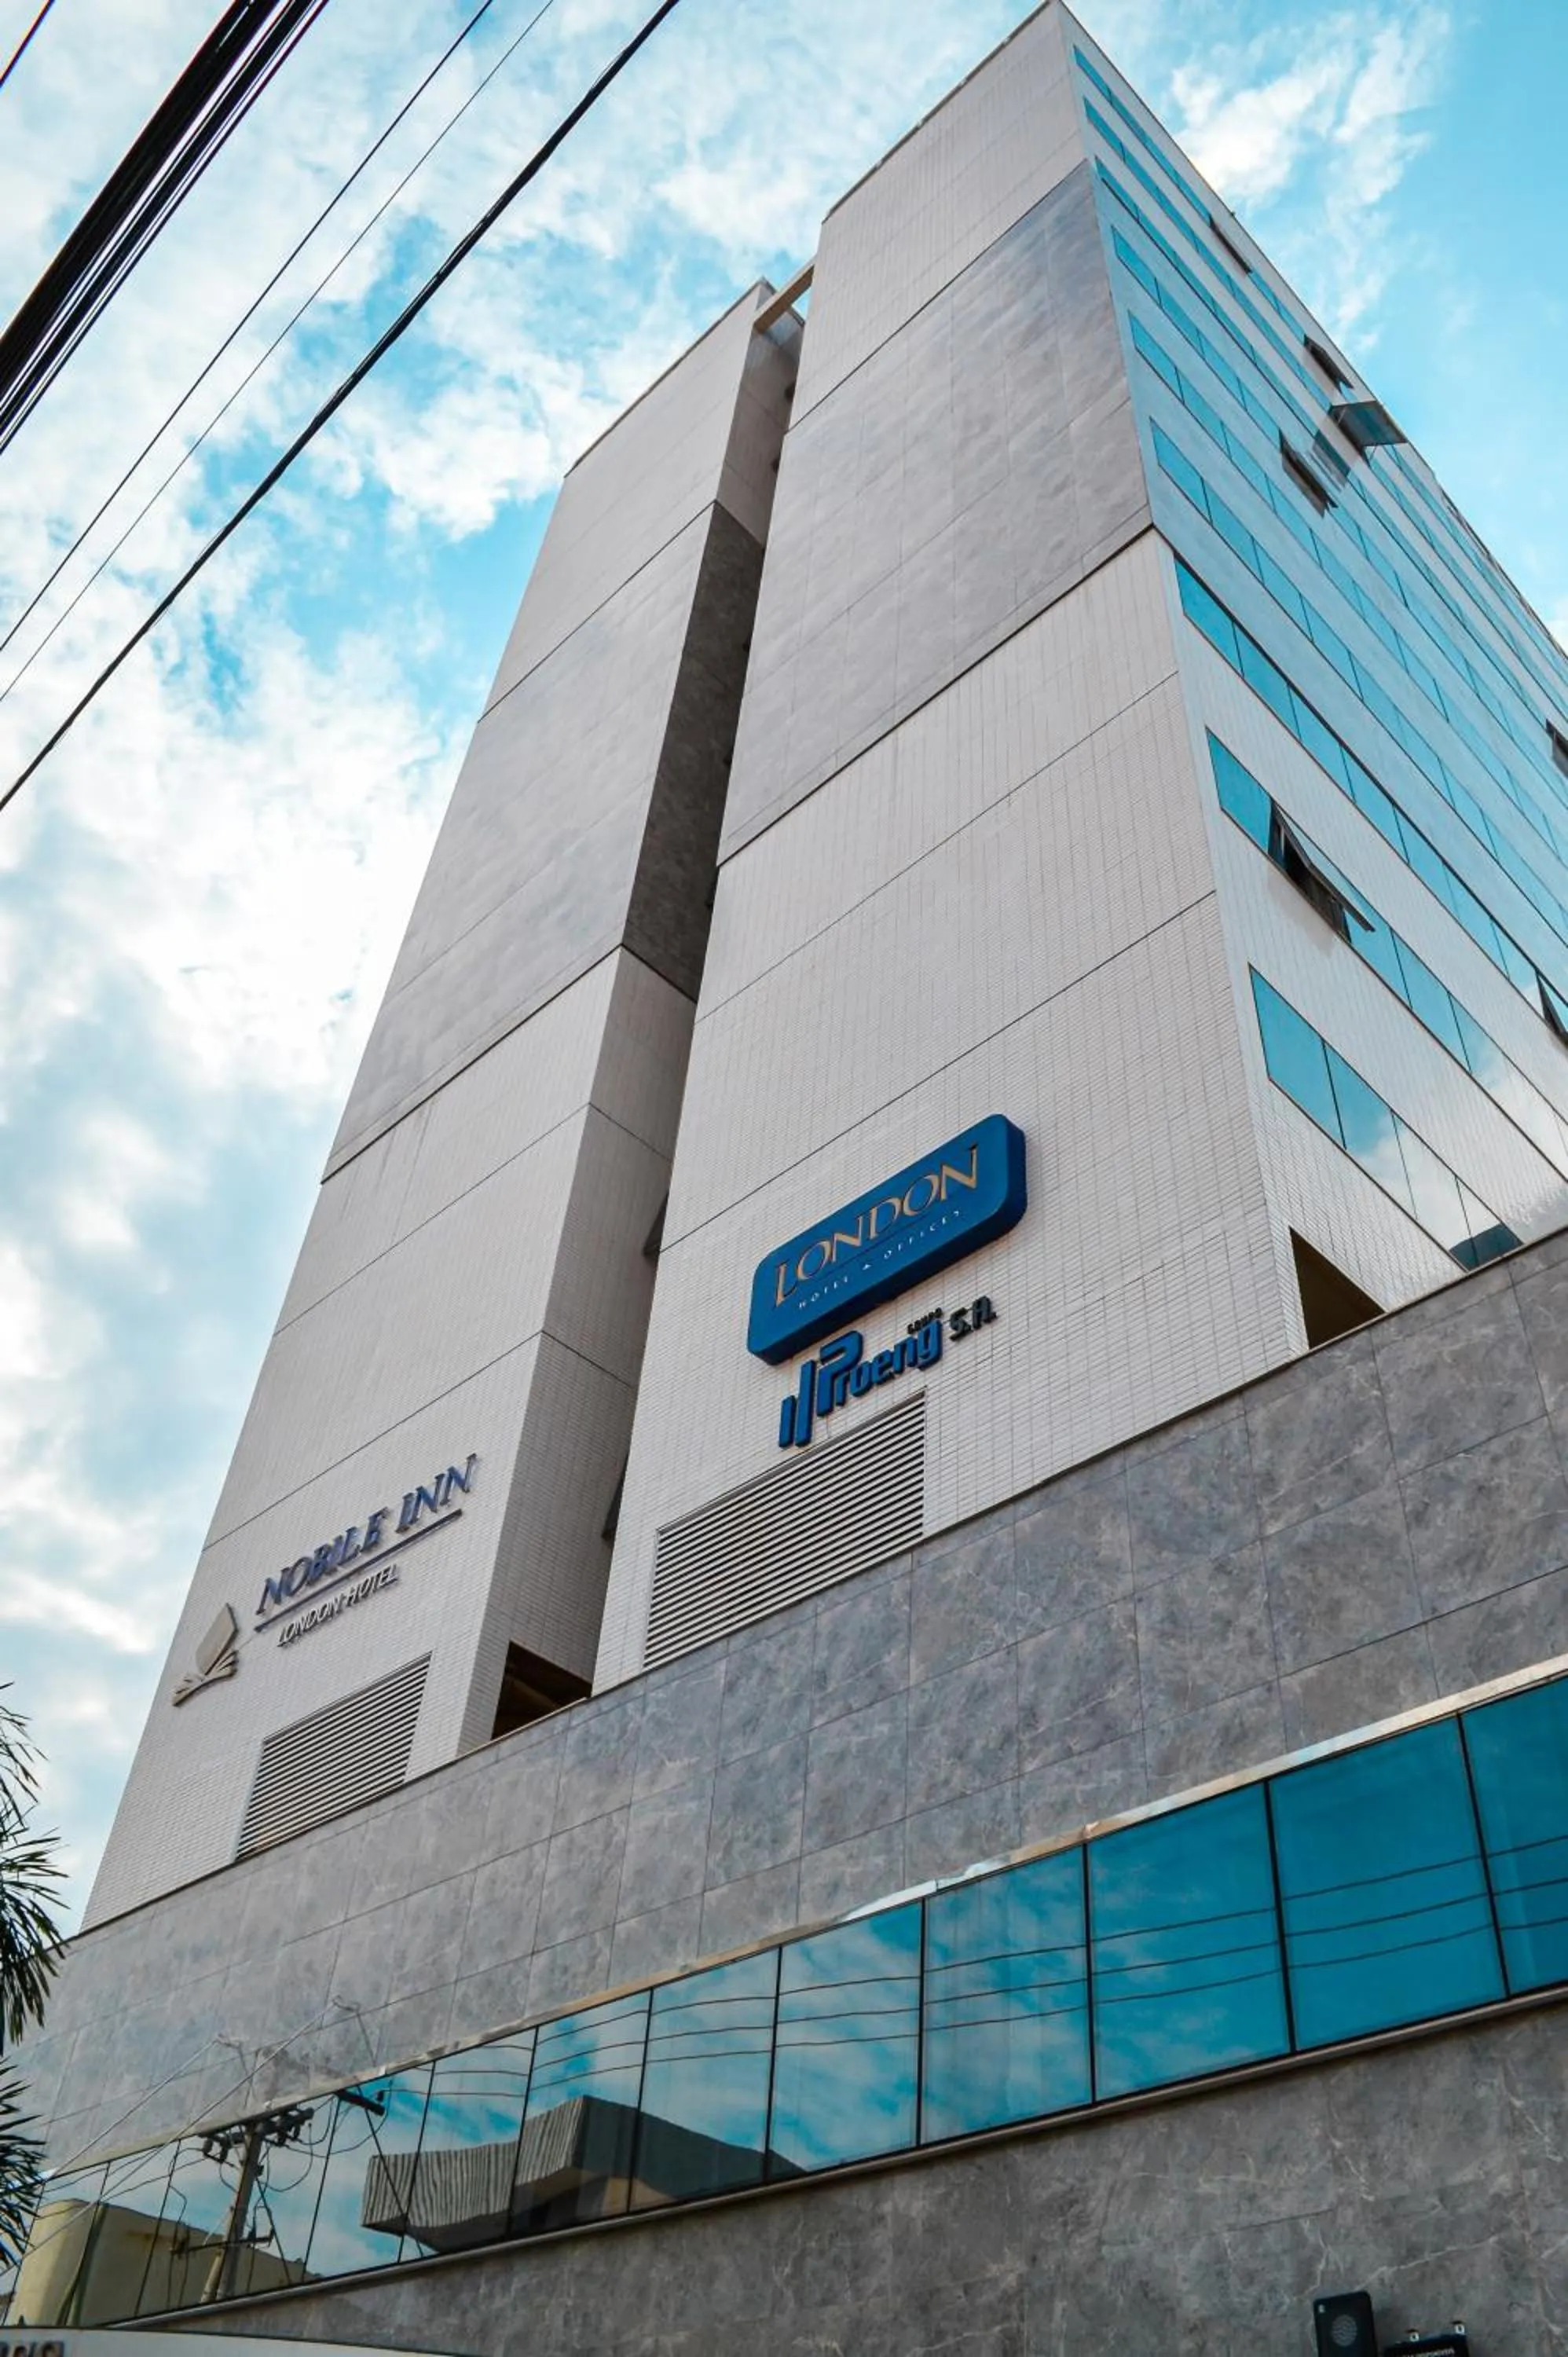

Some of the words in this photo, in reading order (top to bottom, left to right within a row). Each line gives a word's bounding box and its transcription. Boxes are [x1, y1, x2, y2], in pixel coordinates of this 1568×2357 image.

[775, 1143, 979, 1308] LONDON
[255, 1506, 390, 1616] NOBILE
[395, 1453, 477, 1534] INN
[277, 1593, 345, 1647] LONDON
[345, 1563, 398, 1607] HOTEL
